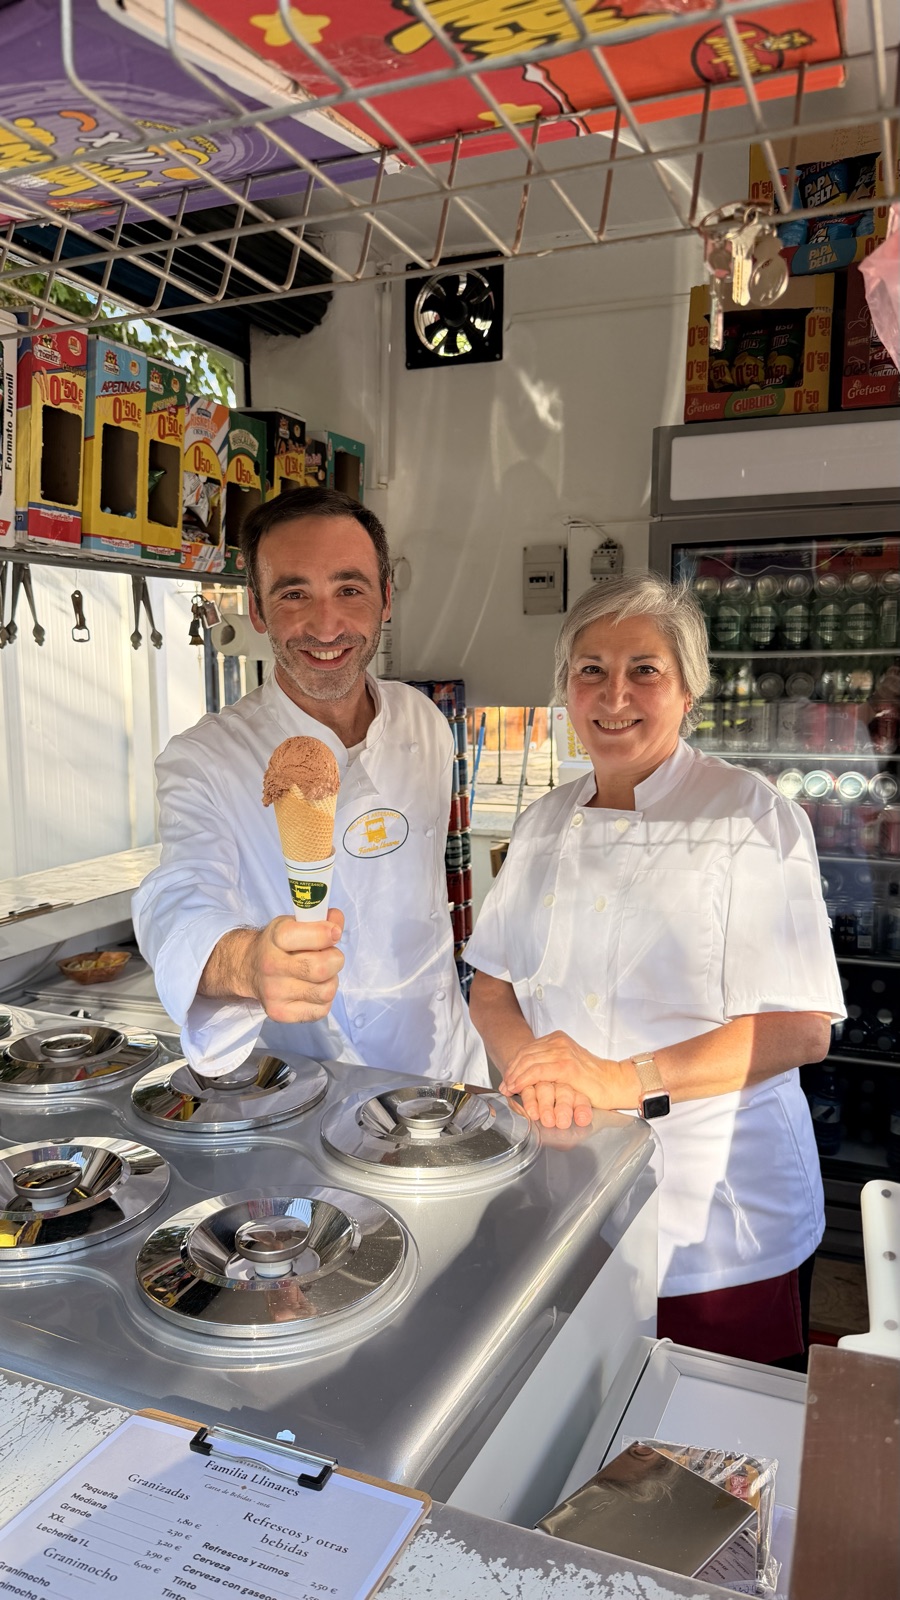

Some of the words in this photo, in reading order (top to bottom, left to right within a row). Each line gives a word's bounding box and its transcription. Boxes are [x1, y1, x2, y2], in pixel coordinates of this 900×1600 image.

[848, 385, 886, 399] Grefusa
[5, 421, 14, 471] Formato
[128, 1473, 191, 1501] Granizadas
[204, 1460, 248, 1481] Familia
[250, 1474, 300, 1497] Llinares
[204, 1483, 221, 1493] Carta
[230, 1491, 252, 1503] Bebidas
[71, 1492, 108, 1510] Mediana
[167, 1528, 183, 1538] 2,30
[81, 1482, 119, 1500] Pequeña
[176, 1517, 193, 1527] 1,80
[48, 1512, 66, 1523] XXL
[144, 1549, 162, 1559] 3,90
[59, 1502, 92, 1518] Grande
[155, 1539, 173, 1548] 3,20
[243, 1511, 303, 1539] Refrescos
[301, 1534, 314, 1544] y
[316, 1538, 350, 1554] otras
[36, 1523, 79, 1543] Lecherita
[133, 1559, 152, 1571] 6,00
[192, 1553, 231, 1572] Cerveza
[260, 1533, 309, 1558] bebidas
[0, 1561, 51, 1587] Granimocho
[43, 1547, 118, 1582] Granimocho
[182, 1564, 221, 1583] Cerveza
[222, 1580, 241, 1591] con
[202, 1541, 249, 1563] Refrescos
[249, 1559, 258, 1567] y
[257, 1562, 290, 1578] zumos
[310, 1581, 328, 1591] 2,50
[330, 1587, 338, 1595] €
[161, 1587, 187, 1600] Tinto
[172, 1575, 197, 1590] Tinto
